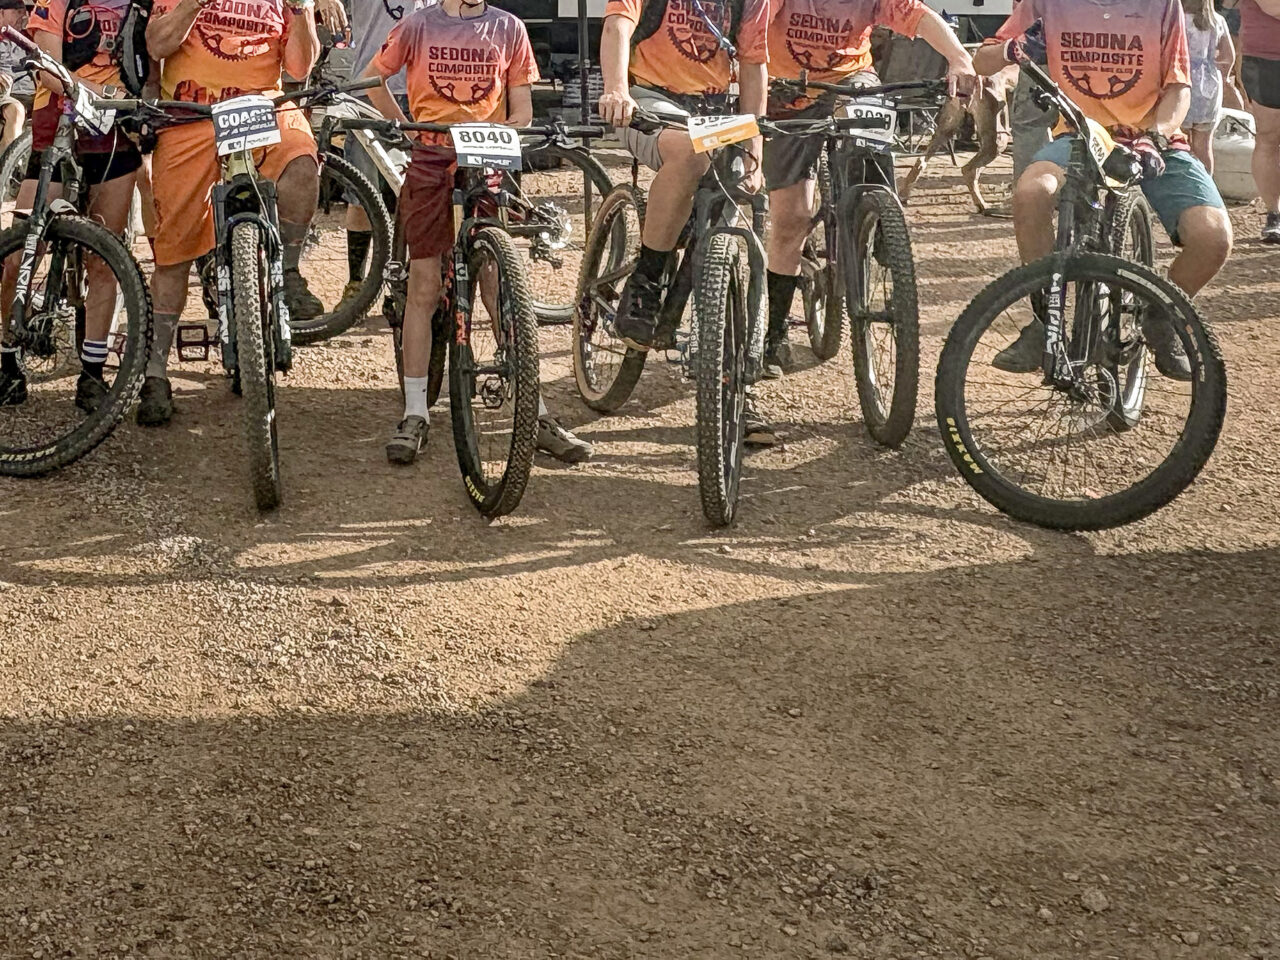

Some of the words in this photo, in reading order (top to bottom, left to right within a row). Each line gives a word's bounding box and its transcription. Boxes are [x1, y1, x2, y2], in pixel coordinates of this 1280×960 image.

[1060, 31, 1144, 51] SEDONA
[428, 46, 497, 63] SEDONA
[1060, 50, 1144, 66] COMPOSITE
[218, 108, 273, 129] COACH
[459, 131, 512, 144] 8040
[946, 417, 984, 474] MAXXIS
